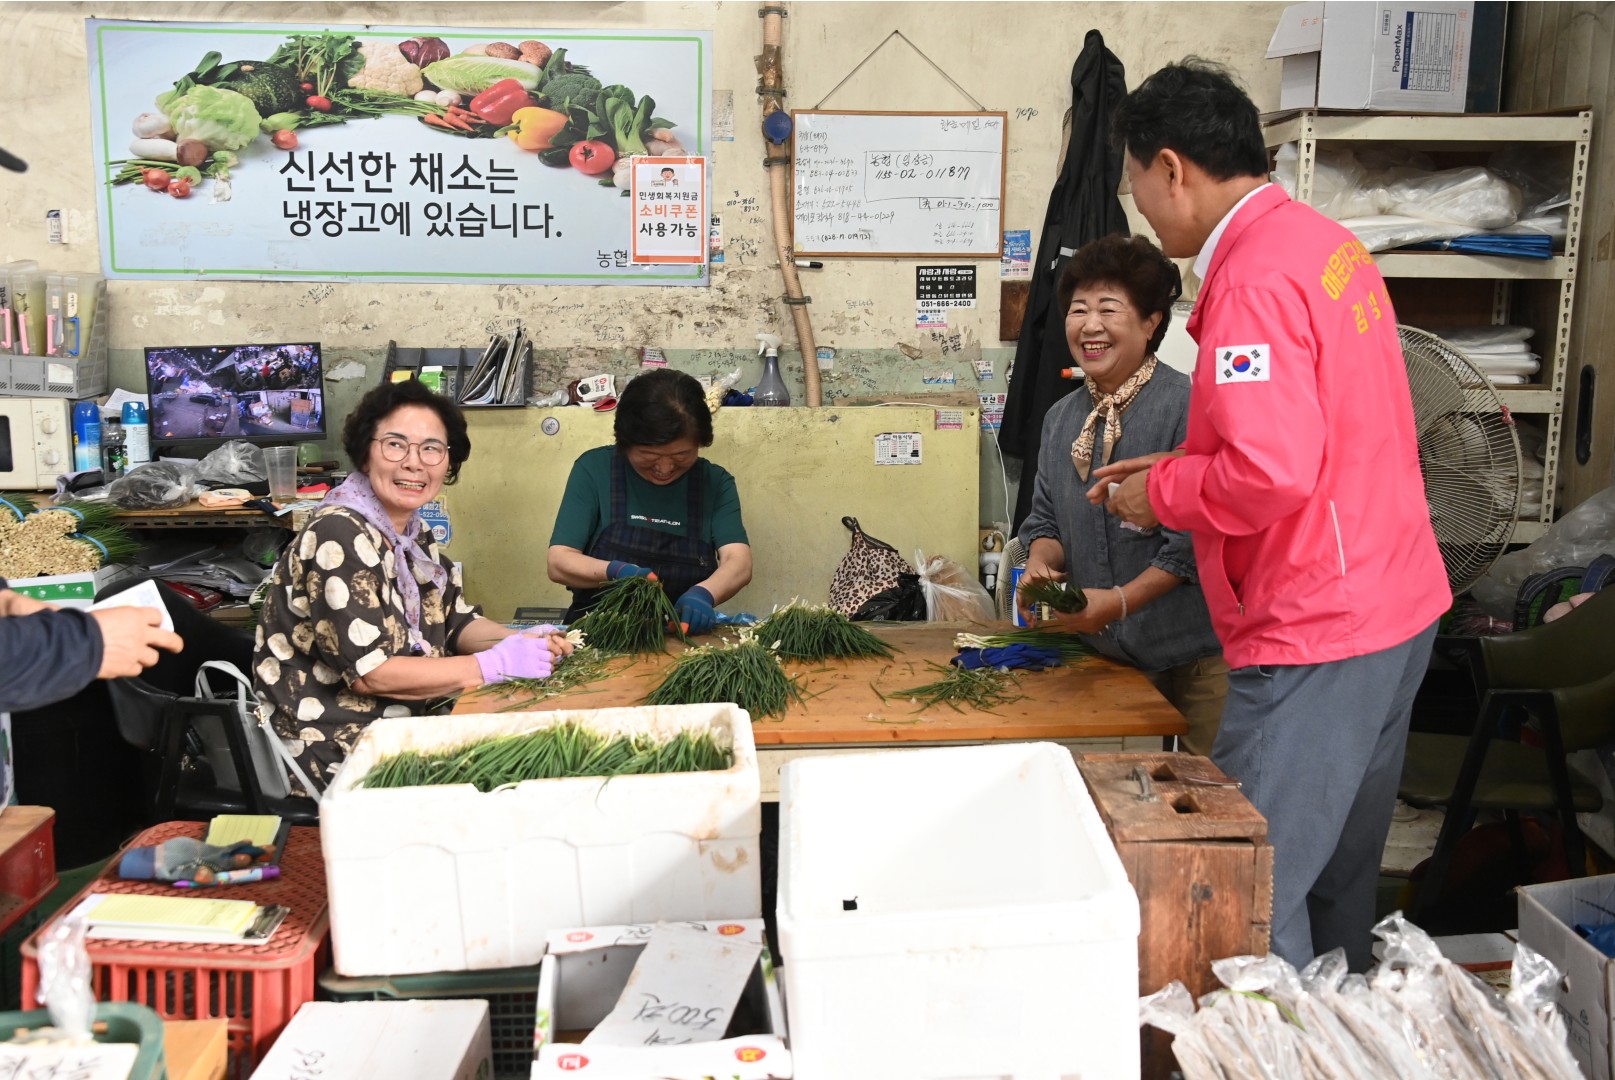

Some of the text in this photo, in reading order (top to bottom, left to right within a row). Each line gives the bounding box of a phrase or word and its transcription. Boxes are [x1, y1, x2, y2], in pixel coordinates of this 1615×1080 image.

[1392, 24, 1403, 73] PaperMax
[280, 151, 518, 194] 신선한 채소는
[639, 192, 698, 200] 민생회복지원금
[283, 200, 562, 238] 냉장고에 있습니다.
[640, 204, 698, 218] 소비쿠폰
[640, 223, 698, 237] 사용가능
[597, 250, 628, 268] 농협
